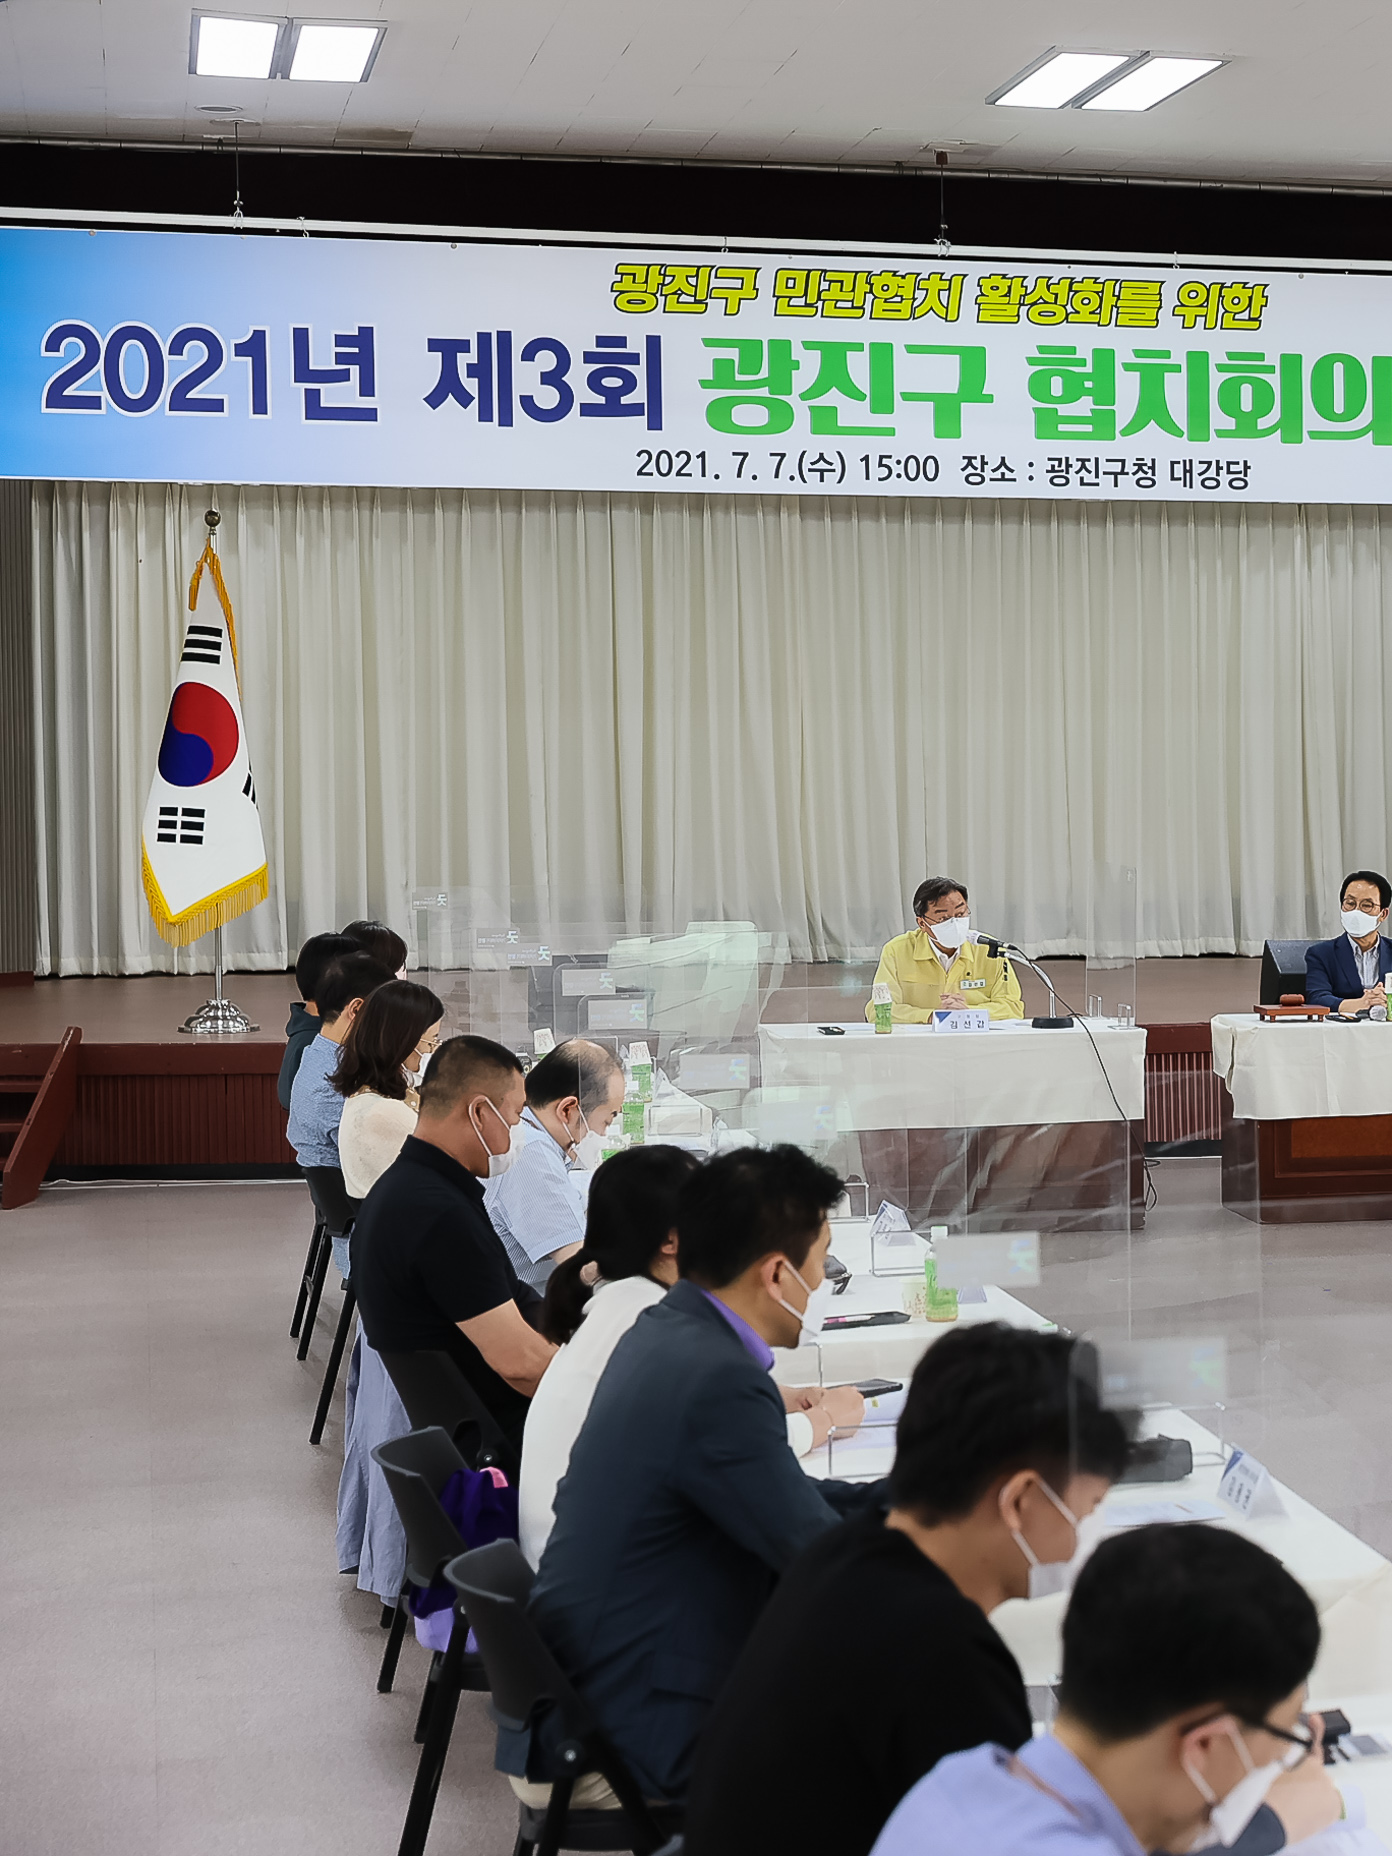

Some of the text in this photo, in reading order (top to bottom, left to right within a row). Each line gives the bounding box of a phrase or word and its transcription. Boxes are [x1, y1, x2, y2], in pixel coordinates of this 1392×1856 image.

[611, 263, 1270, 331] 광진구 민관협치 활성화를 위한
[43, 322, 380, 423] 2021년
[424, 329, 664, 431] 제3회
[698, 336, 995, 440] 광진구
[636, 449, 721, 479] 2021.
[859, 454, 940, 483] 15:00
[1044, 455, 1157, 488] 광진구청
[1167, 459, 1251, 490] 대강당
